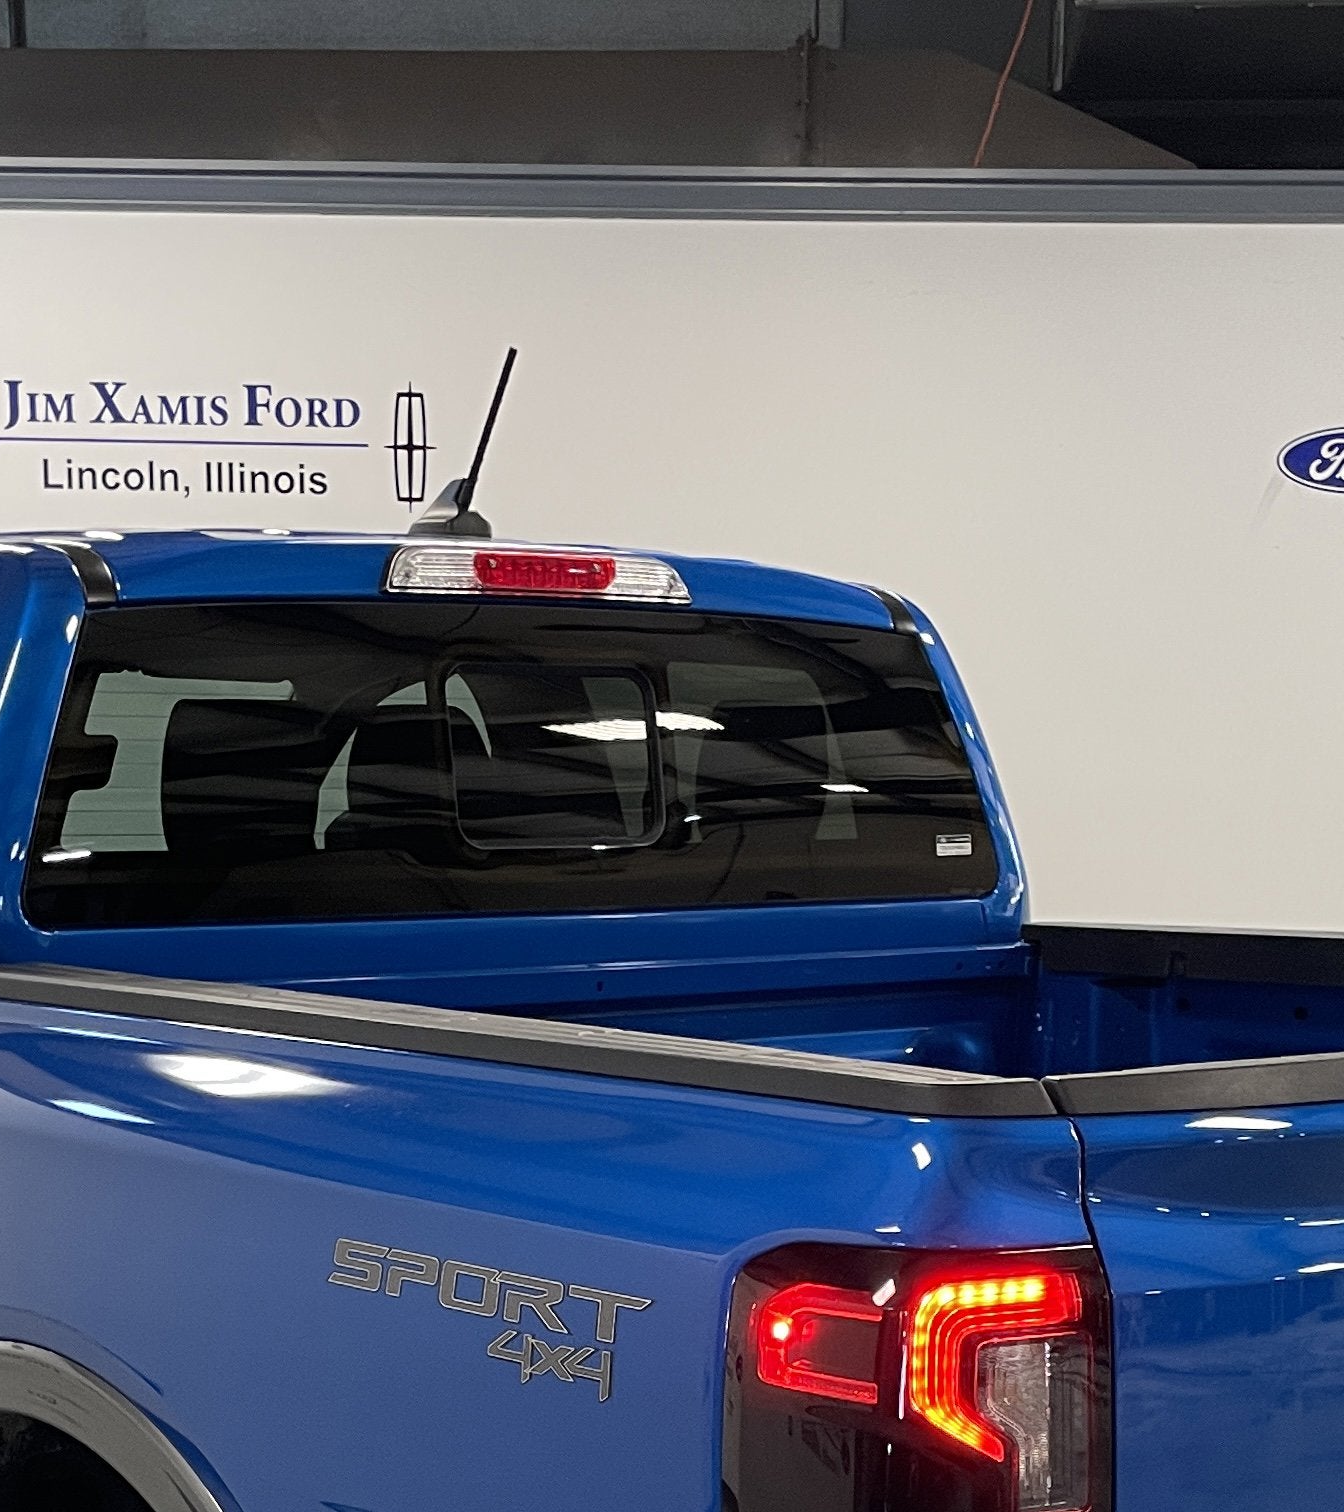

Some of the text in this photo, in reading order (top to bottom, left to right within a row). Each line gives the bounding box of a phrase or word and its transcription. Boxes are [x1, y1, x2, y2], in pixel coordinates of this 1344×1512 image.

[3, 379, 361, 430] JIM XAMIS FORD
[43, 458, 328, 498] Lincoln, Illinois
[327, 1236, 652, 1343] SPORT
[487, 1329, 612, 1402] 4x4
